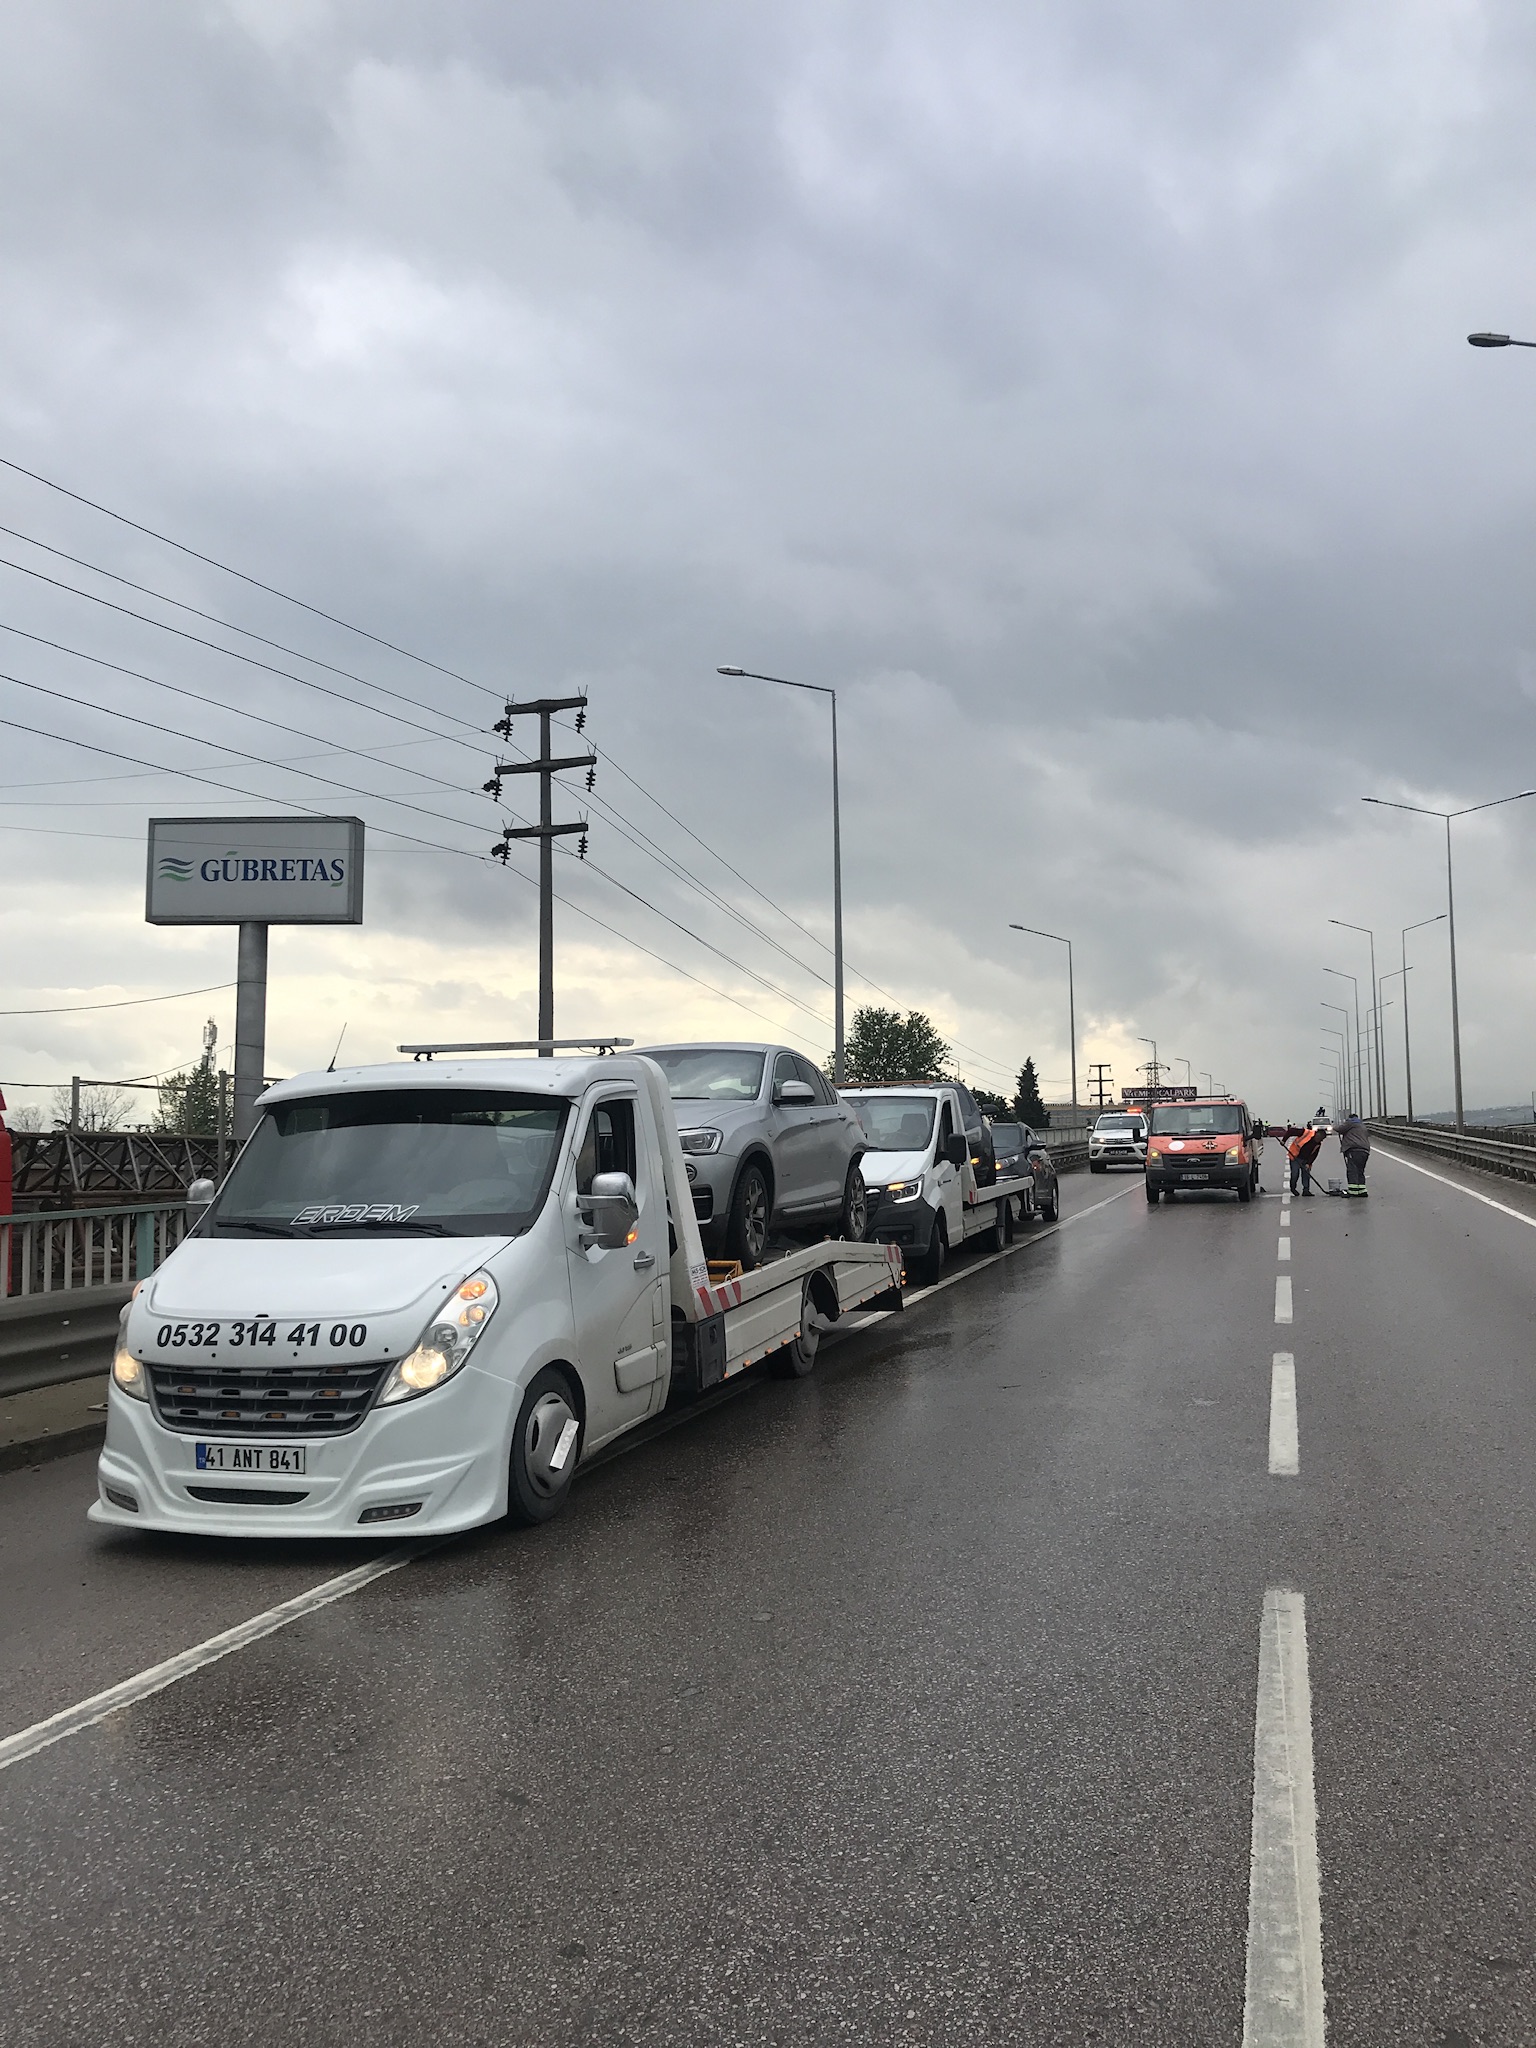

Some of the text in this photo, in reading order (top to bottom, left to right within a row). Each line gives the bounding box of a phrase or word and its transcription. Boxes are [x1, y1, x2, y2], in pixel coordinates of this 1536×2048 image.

[289, 1204, 420, 1225] ERDEM
[157, 1322, 367, 1347] 0532 314 41 00
[206, 1447, 300, 1470] 41 ANT 841
